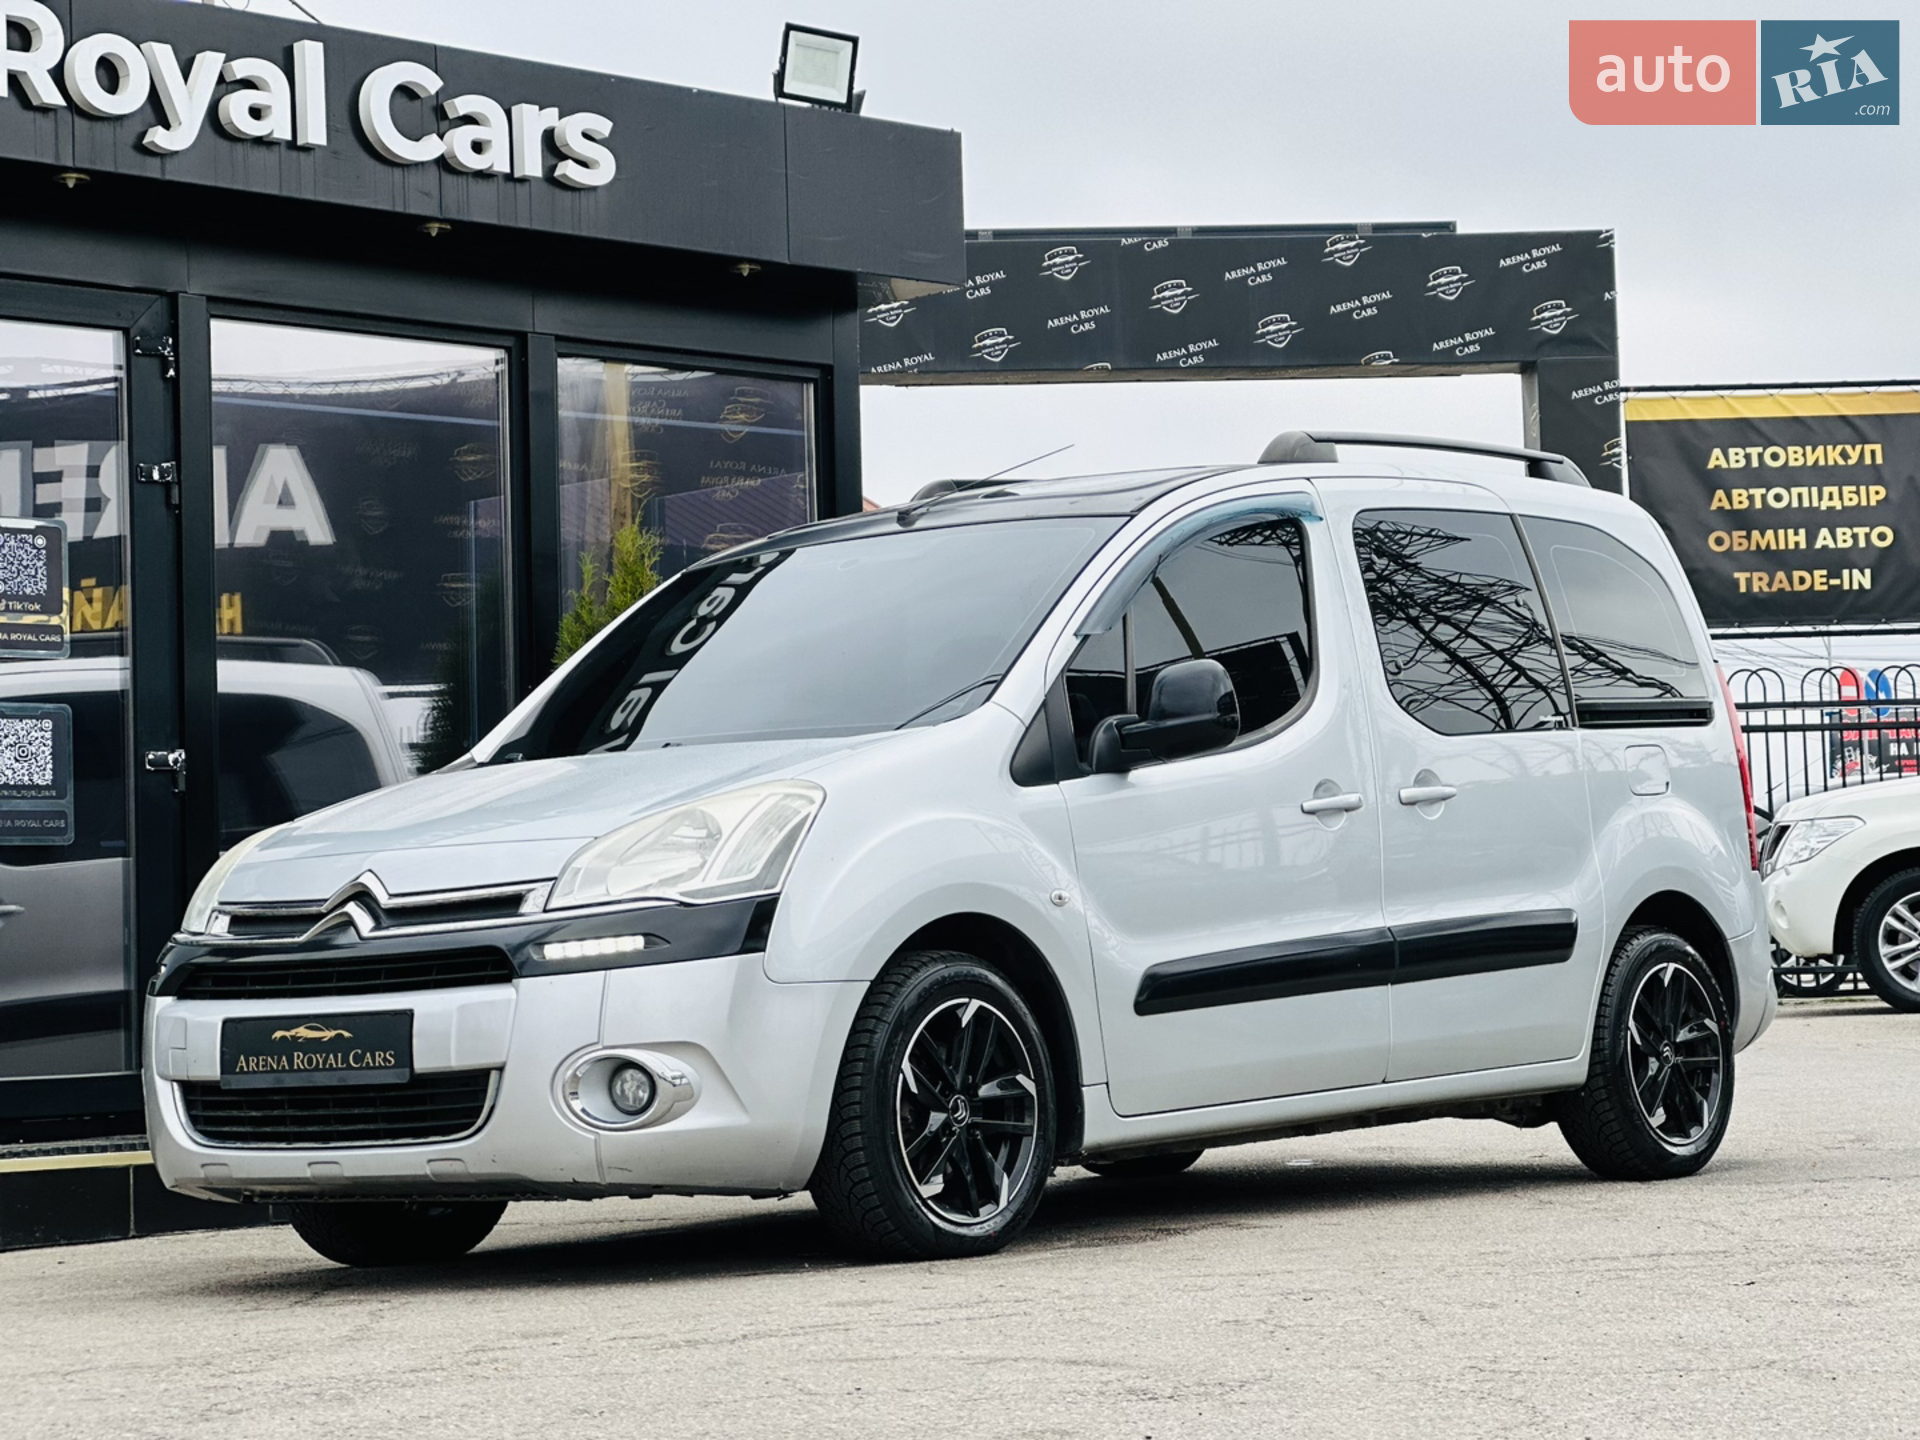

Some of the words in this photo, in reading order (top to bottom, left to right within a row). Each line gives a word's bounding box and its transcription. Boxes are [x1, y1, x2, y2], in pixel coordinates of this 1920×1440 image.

[0, 0, 328, 154] Royal
[358, 60, 618, 189] Cars
[1144, 238, 1169, 252] CARS
[1499, 252, 1531, 268] ARENA
[1531, 243, 1563, 259] ROYAL
[1224, 266, 1256, 281] ARENA
[1256, 256, 1288, 272] ROYAL
[1522, 259, 1548, 273] CARS
[975, 270, 1007, 286] ROYAL
[1247, 273, 1273, 286] CARS
[966, 286, 992, 300] CARS
[1329, 299, 1361, 315] ARENA
[1361, 290, 1393, 307] ROYAL
[1047, 313, 1079, 329] ARENA
[1079, 304, 1111, 321] ROYAL
[1353, 305, 1378, 320] CARS
[1070, 320, 1096, 334] CARS
[1432, 336, 1464, 352] ARENA
[1464, 326, 1496, 343] ROYAL
[1155, 347, 1187, 363] ARENA
[1187, 337, 1220, 354] ROYAL
[1455, 342, 1481, 357] CARS
[870, 360, 902, 374] ARENA
[903, 352, 935, 367] ROYAL
[1179, 353, 1205, 368] CARS
[1571, 385, 1603, 400] ARENA
[1594, 392, 1620, 405] CARS
[1707, 443, 1884, 470] АВТОВИКУП
[1710, 485, 1887, 511] АВТОПІДБІР
[1707, 527, 1808, 553] ОБМІН
[1814, 525, 1895, 549] АВТО
[1734, 568, 1872, 593] TRADE-IN
[8, 601, 41, 611] TikTok
[10, 633, 38, 641] ROYAL
[39, 634, 62, 642] CARS
[236, 1055, 288, 1073] ARENA
[293, 1051, 346, 1070] ROYAL
[348, 1049, 395, 1068] CARS
